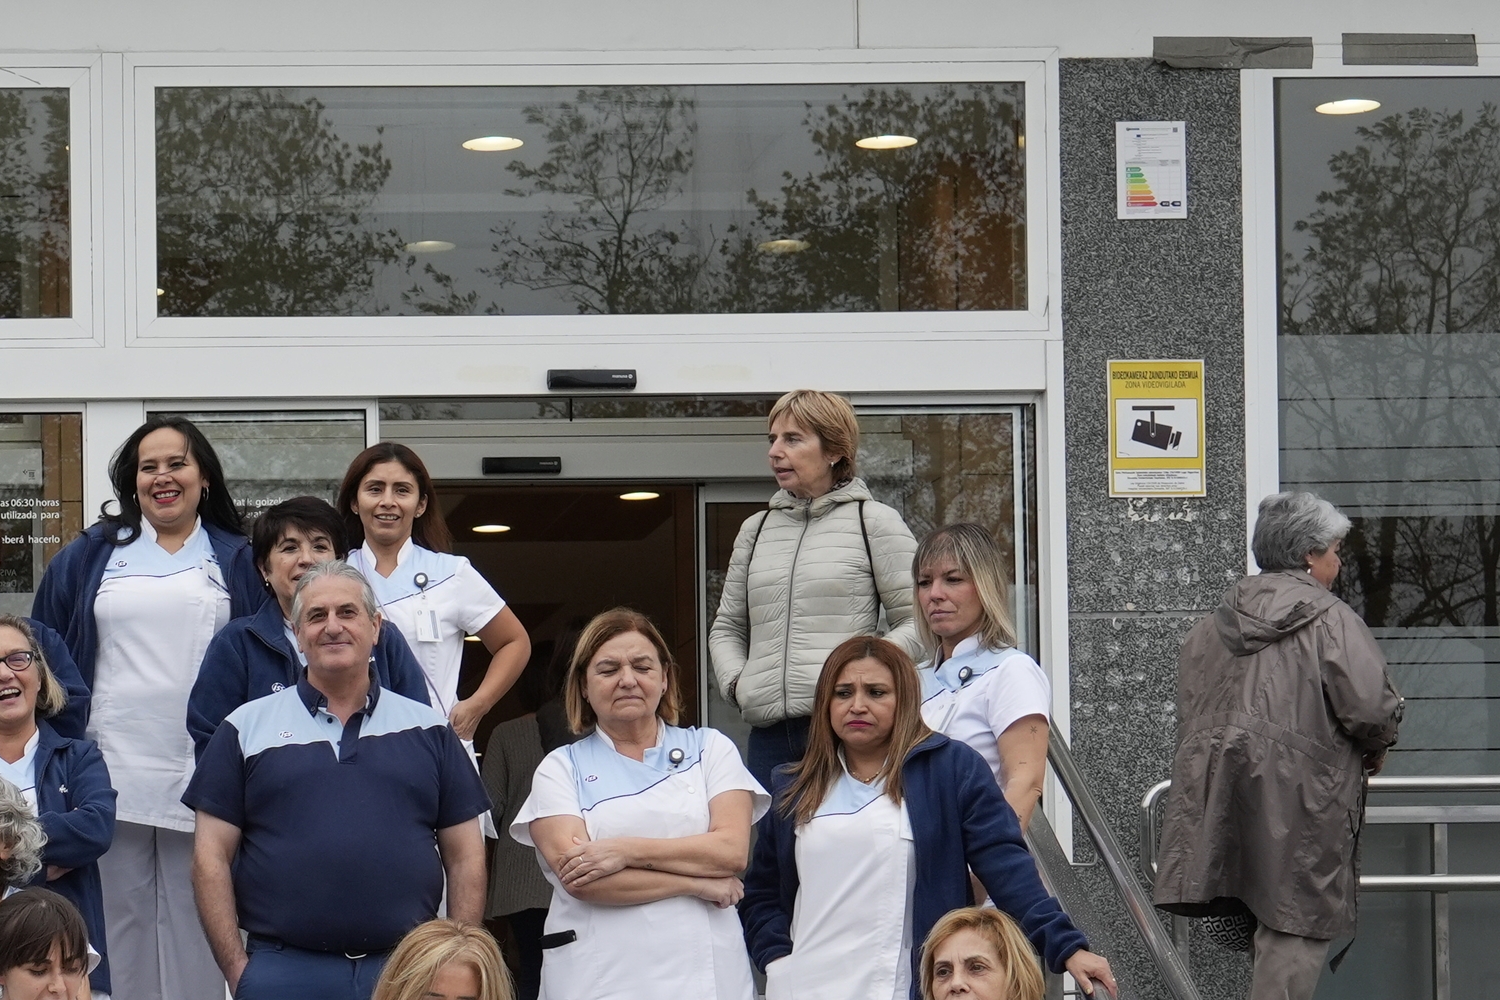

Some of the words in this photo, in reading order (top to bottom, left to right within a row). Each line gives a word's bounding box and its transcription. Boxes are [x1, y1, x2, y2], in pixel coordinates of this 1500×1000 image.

[1112, 370, 1148, 380] BIDEOKAMERAZ
[1149, 370, 1178, 380] ZAINDUTAKO
[1178, 370, 1199, 380] EREMUA
[1125, 381, 1140, 389] ZONA
[1141, 381, 1186, 389] VIDEOVIGILADA
[11, 498, 34, 508] 06:30
[35, 498, 60, 507] horas
[0, 511, 37, 520] utilizada
[40, 513, 60, 521] para
[28, 535, 60, 544] hacerlo
